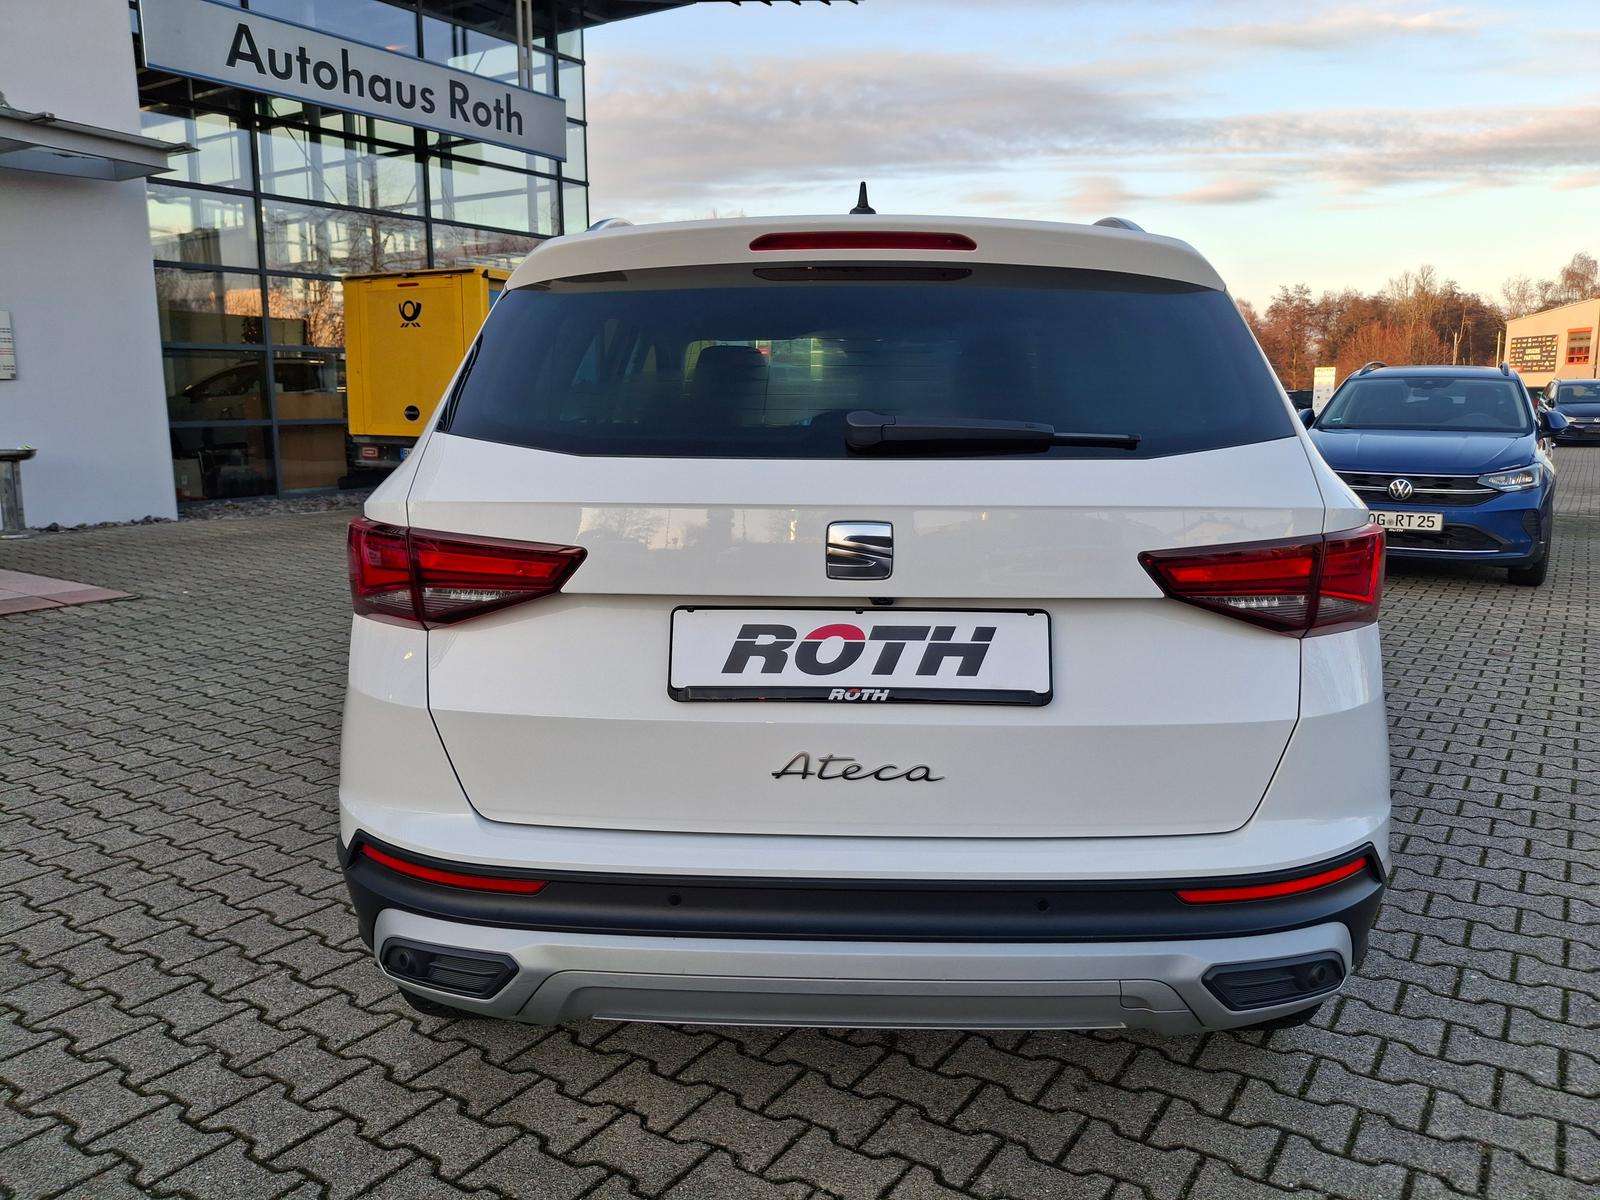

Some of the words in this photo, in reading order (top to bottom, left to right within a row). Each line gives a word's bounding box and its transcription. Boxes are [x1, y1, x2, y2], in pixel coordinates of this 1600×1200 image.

[226, 23, 436, 114] Autohaus
[450, 80, 523, 135] Roth
[1395, 514, 1414, 527] RT
[1417, 515, 1435, 528] 25
[721, 624, 997, 677] ROTH
[828, 688, 890, 701] ROTH
[771, 750, 946, 783] Ateca
